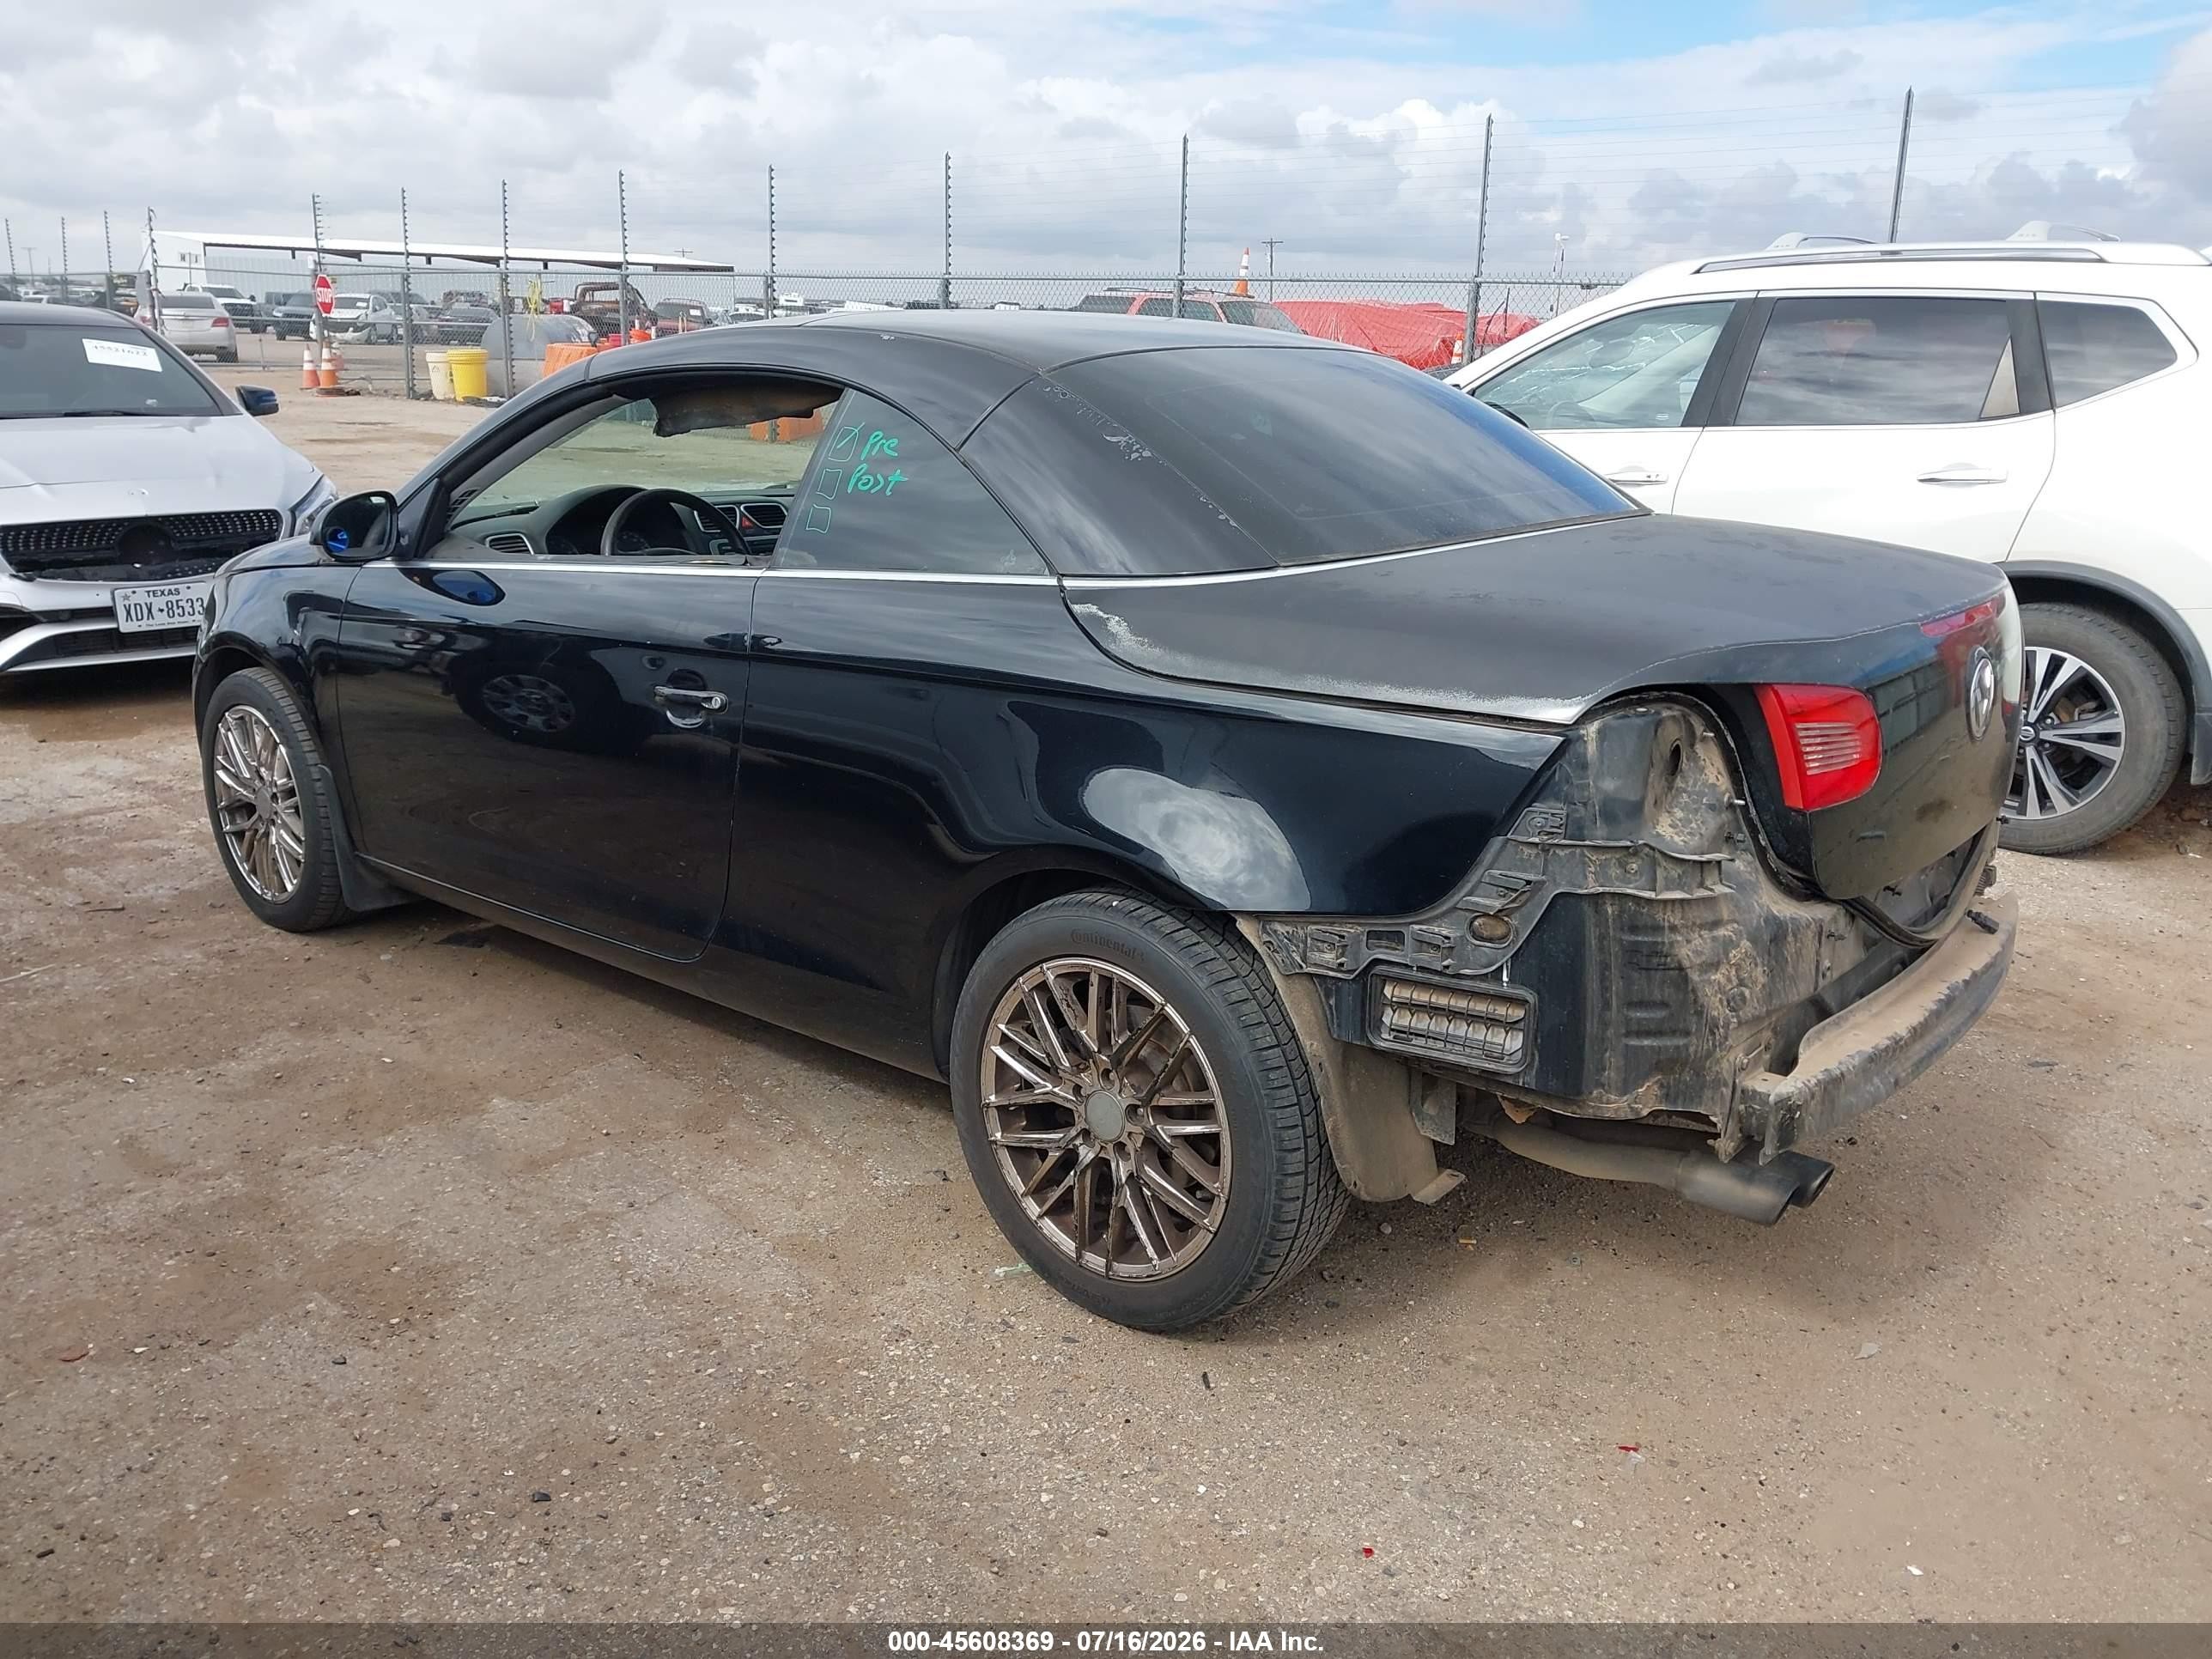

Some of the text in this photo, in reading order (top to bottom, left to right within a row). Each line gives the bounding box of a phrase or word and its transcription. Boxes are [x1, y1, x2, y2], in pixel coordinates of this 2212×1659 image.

[317, 288, 332, 303] STOP
[860, 430, 899, 460] Pre
[847, 463, 908, 496] Post
[145, 588, 180, 599] TEXAS
[166, 597, 205, 619] 8533
[1070, 928, 1138, 960] Continental
